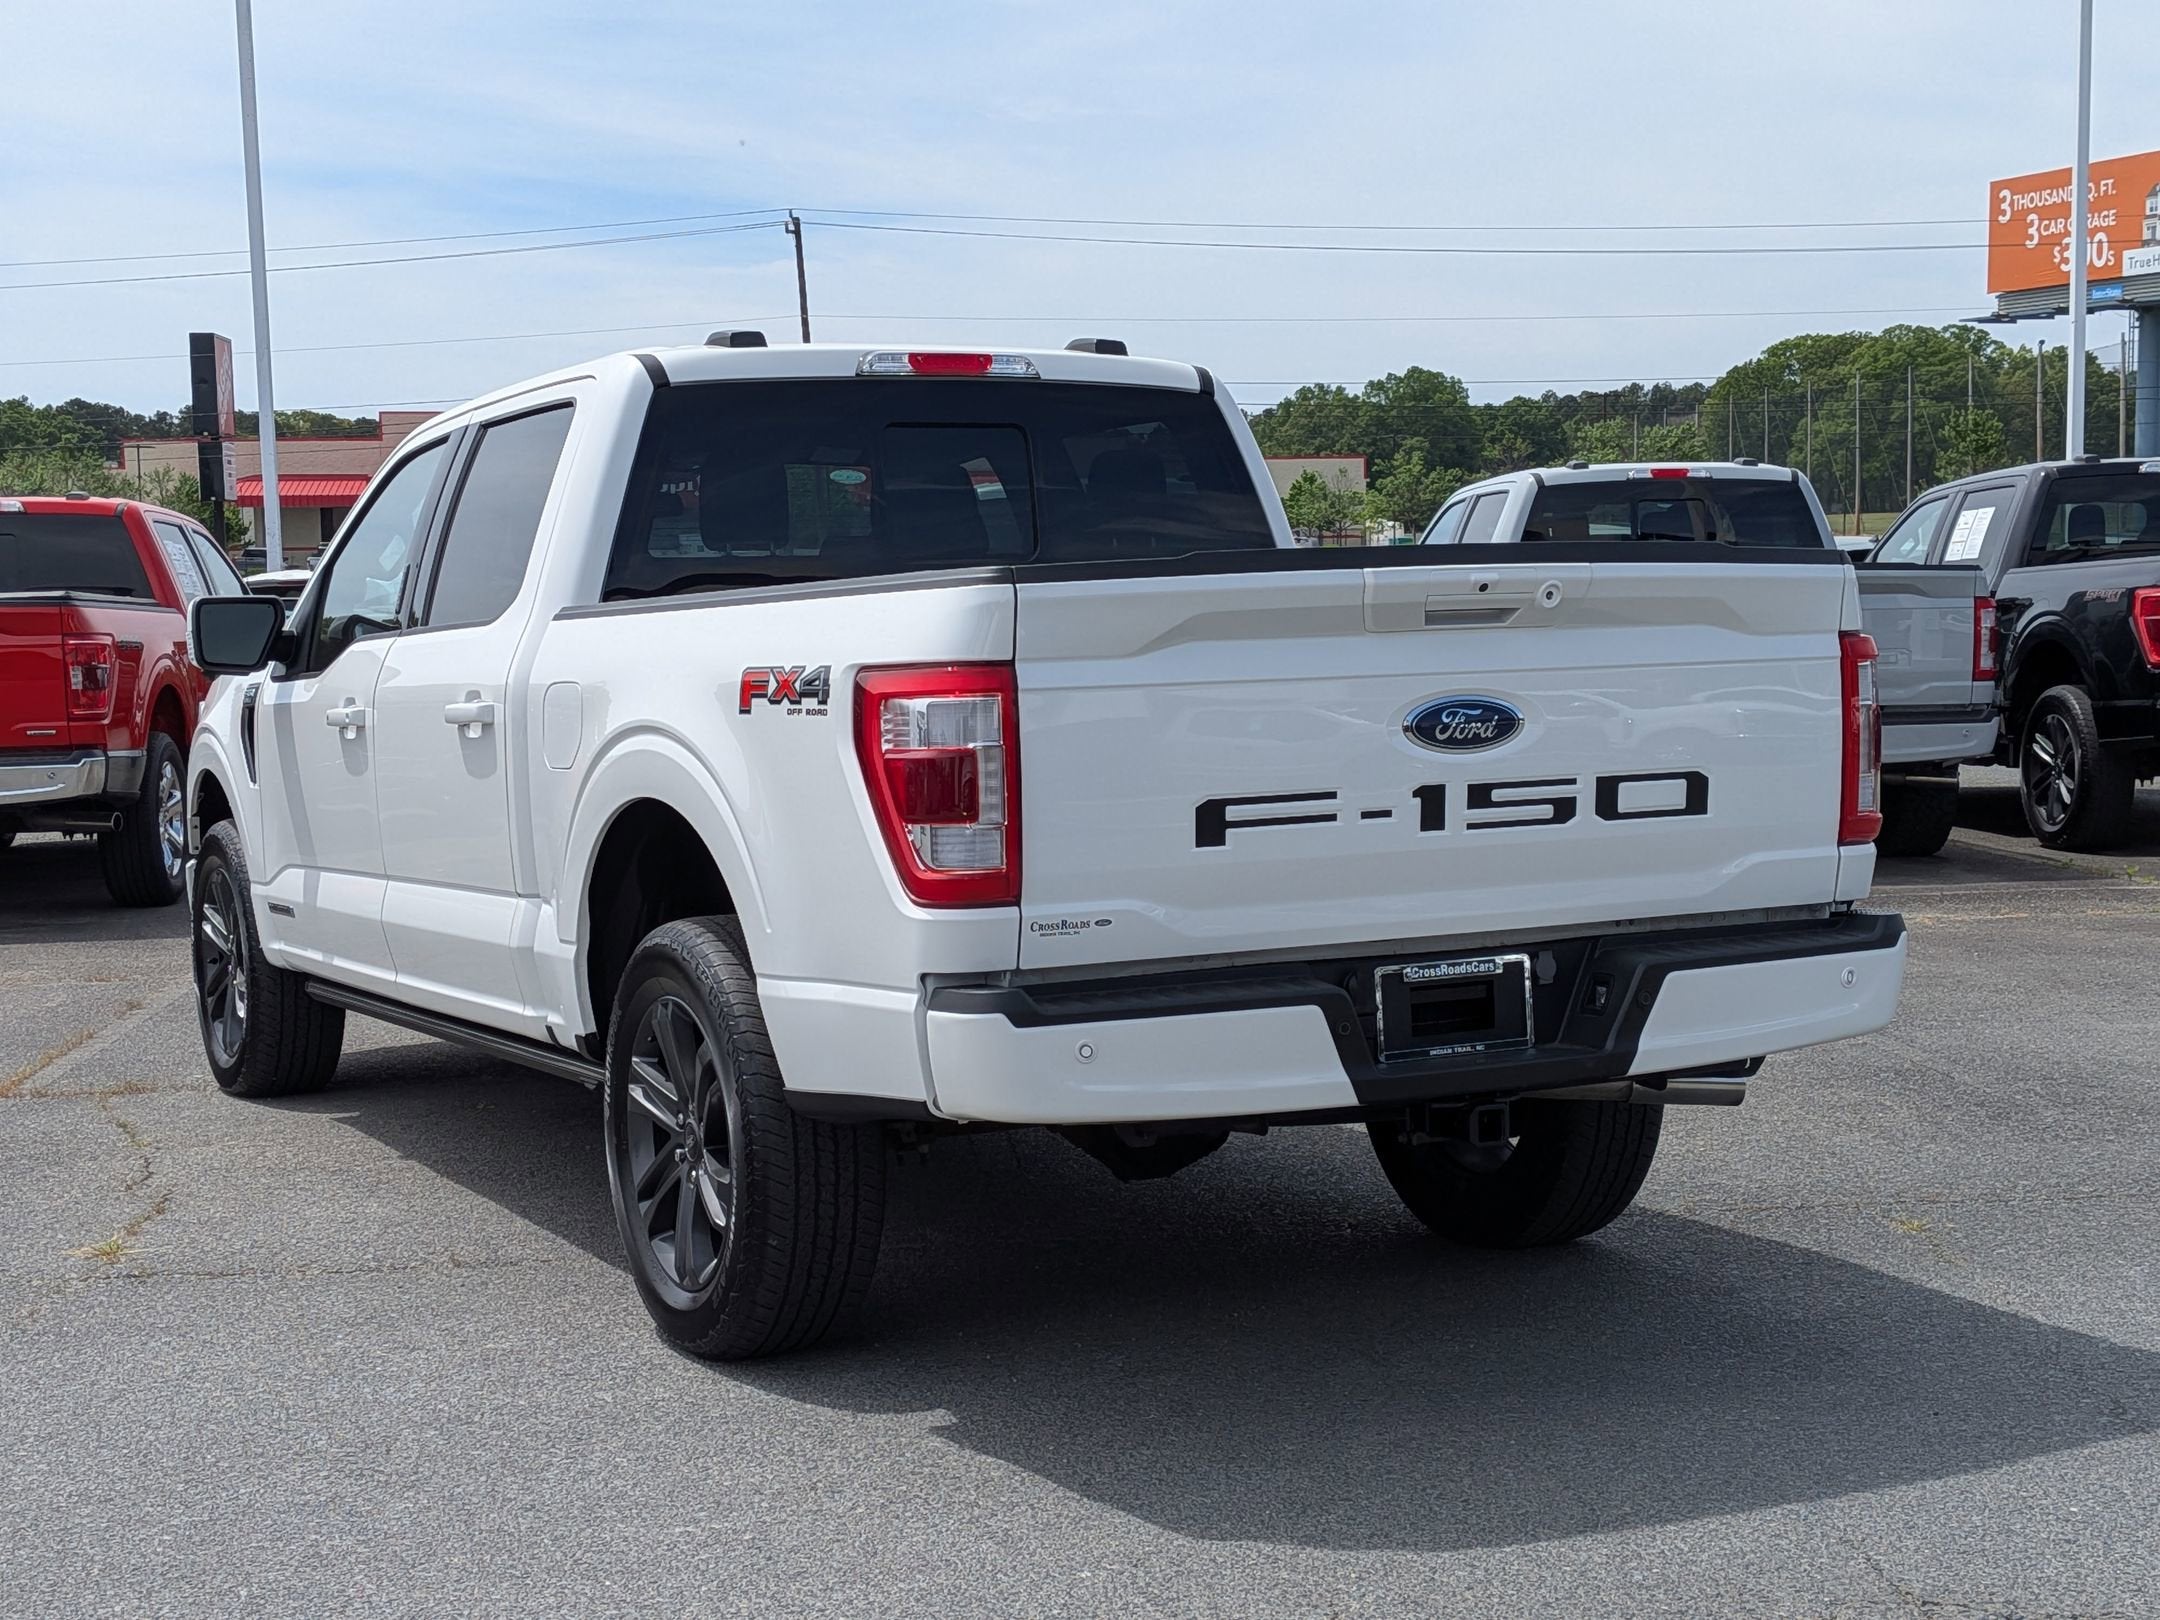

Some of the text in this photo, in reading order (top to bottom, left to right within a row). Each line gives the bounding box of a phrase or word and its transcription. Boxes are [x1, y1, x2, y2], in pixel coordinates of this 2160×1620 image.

[1998, 189, 2012, 224] 3
[2100, 179, 2118, 197] FT.
[2025, 213, 2040, 249] 3
[2040, 218, 2065, 236] CAR
[738, 664, 832, 715] FX4
[786, 708, 828, 717] OFF ROAD
[1435, 708, 1499, 741] Ford
[1195, 770, 1710, 849] F-150
